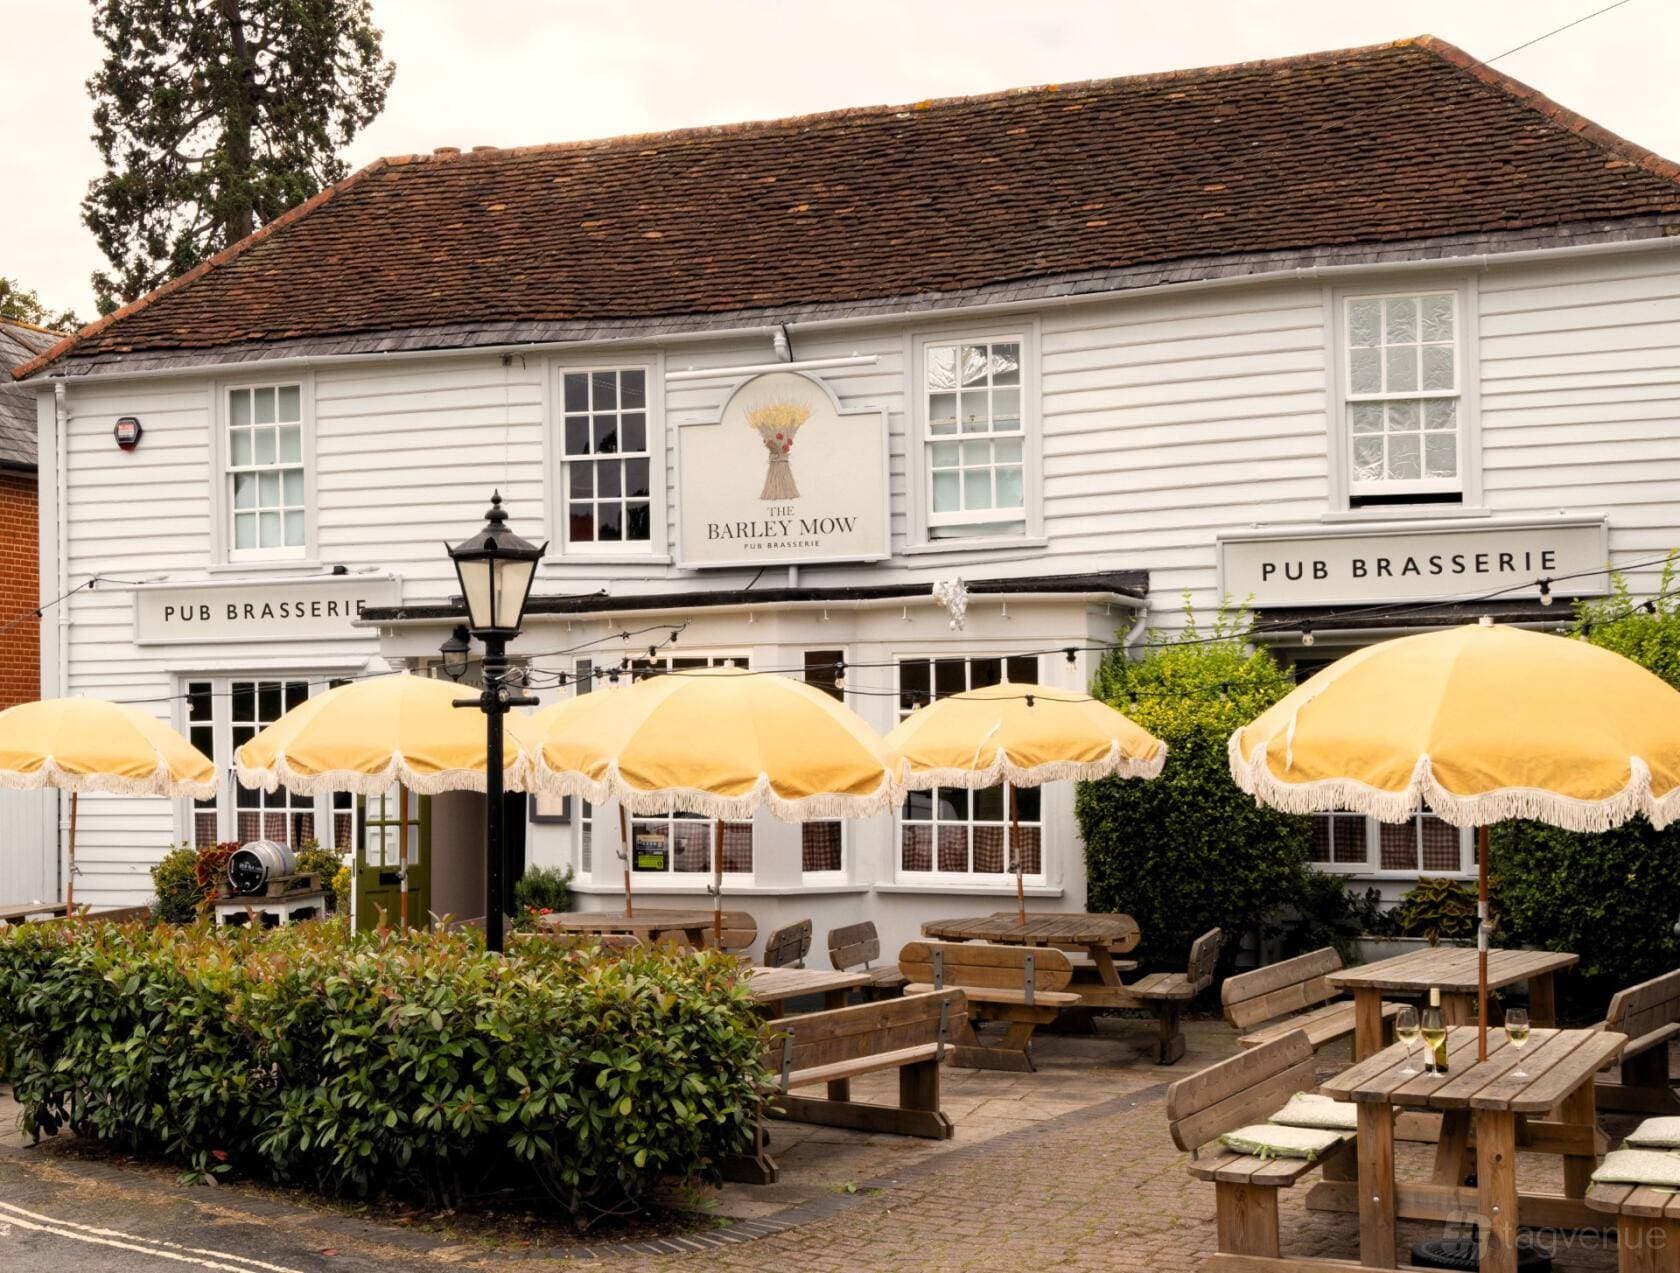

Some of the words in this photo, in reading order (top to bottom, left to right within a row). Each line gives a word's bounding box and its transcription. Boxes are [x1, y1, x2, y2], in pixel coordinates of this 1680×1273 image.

[767, 506, 795, 517] THE
[707, 520, 793, 539] BARLEY
[800, 517, 857, 535] MOW
[767, 540, 820, 549] BRASSERIE
[1262, 560, 1329, 581] PUB
[1352, 550, 1556, 578] BRASSERIE
[164, 605, 211, 622] PUB
[227, 599, 367, 620] BRASSERIE
